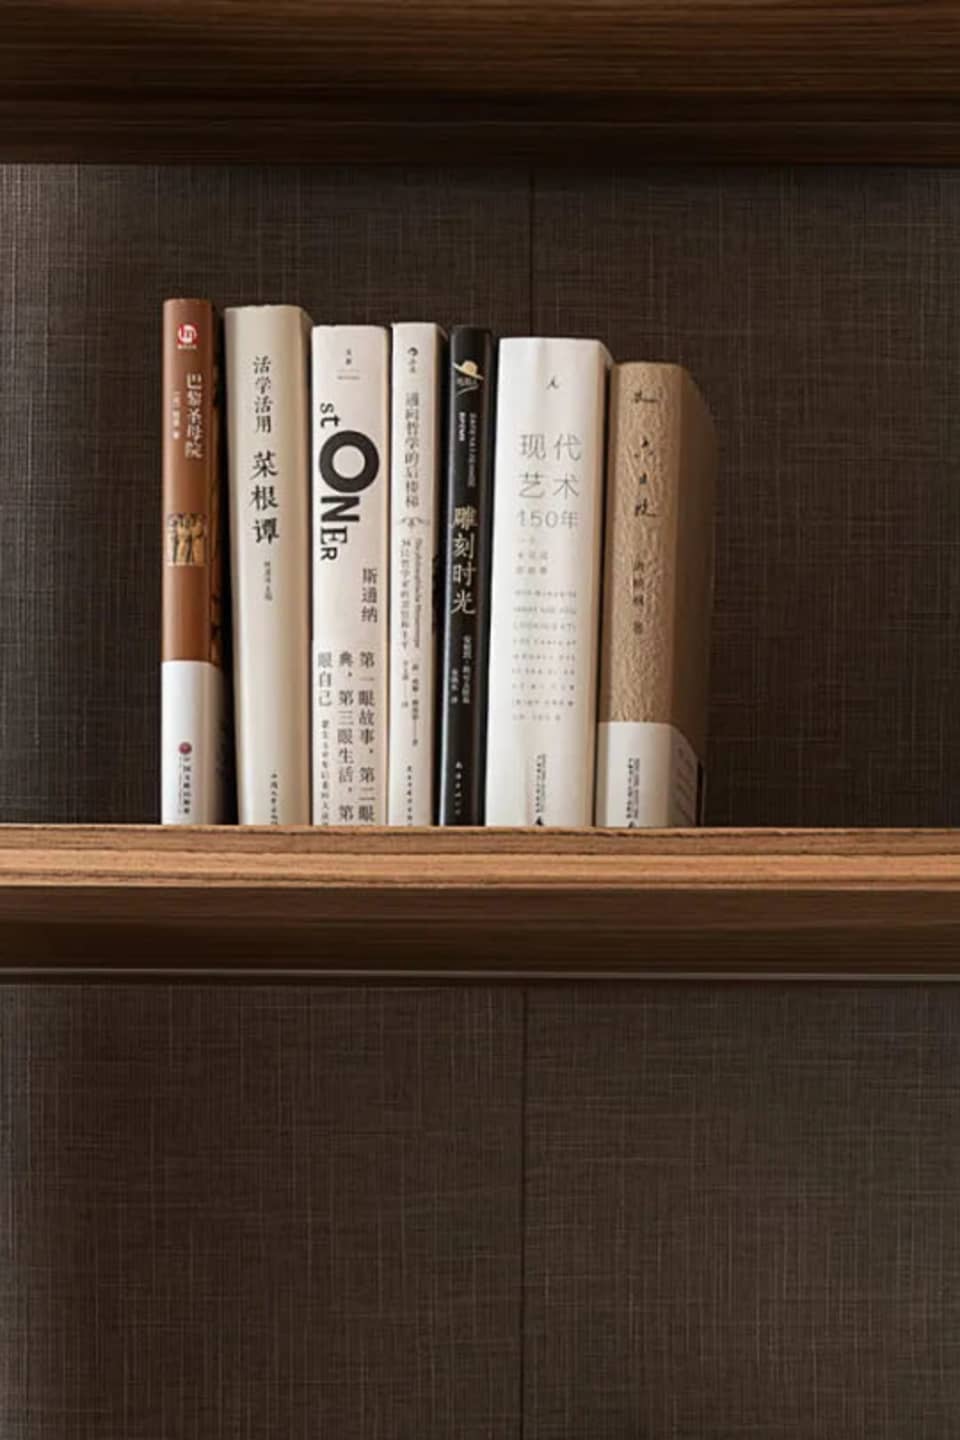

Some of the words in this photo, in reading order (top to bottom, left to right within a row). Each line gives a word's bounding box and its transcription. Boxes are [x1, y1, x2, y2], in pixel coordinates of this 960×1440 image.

[253, 355, 273, 434] 活学活用
[519, 433, 583, 462] 现代
[250, 450, 280, 545] 菜根谭
[519, 472, 580, 500] 艺术
[517, 508, 579, 529] 150年
[449, 505, 478, 615] 雕刻时光
[361, 567, 378, 624] 斯通纳
